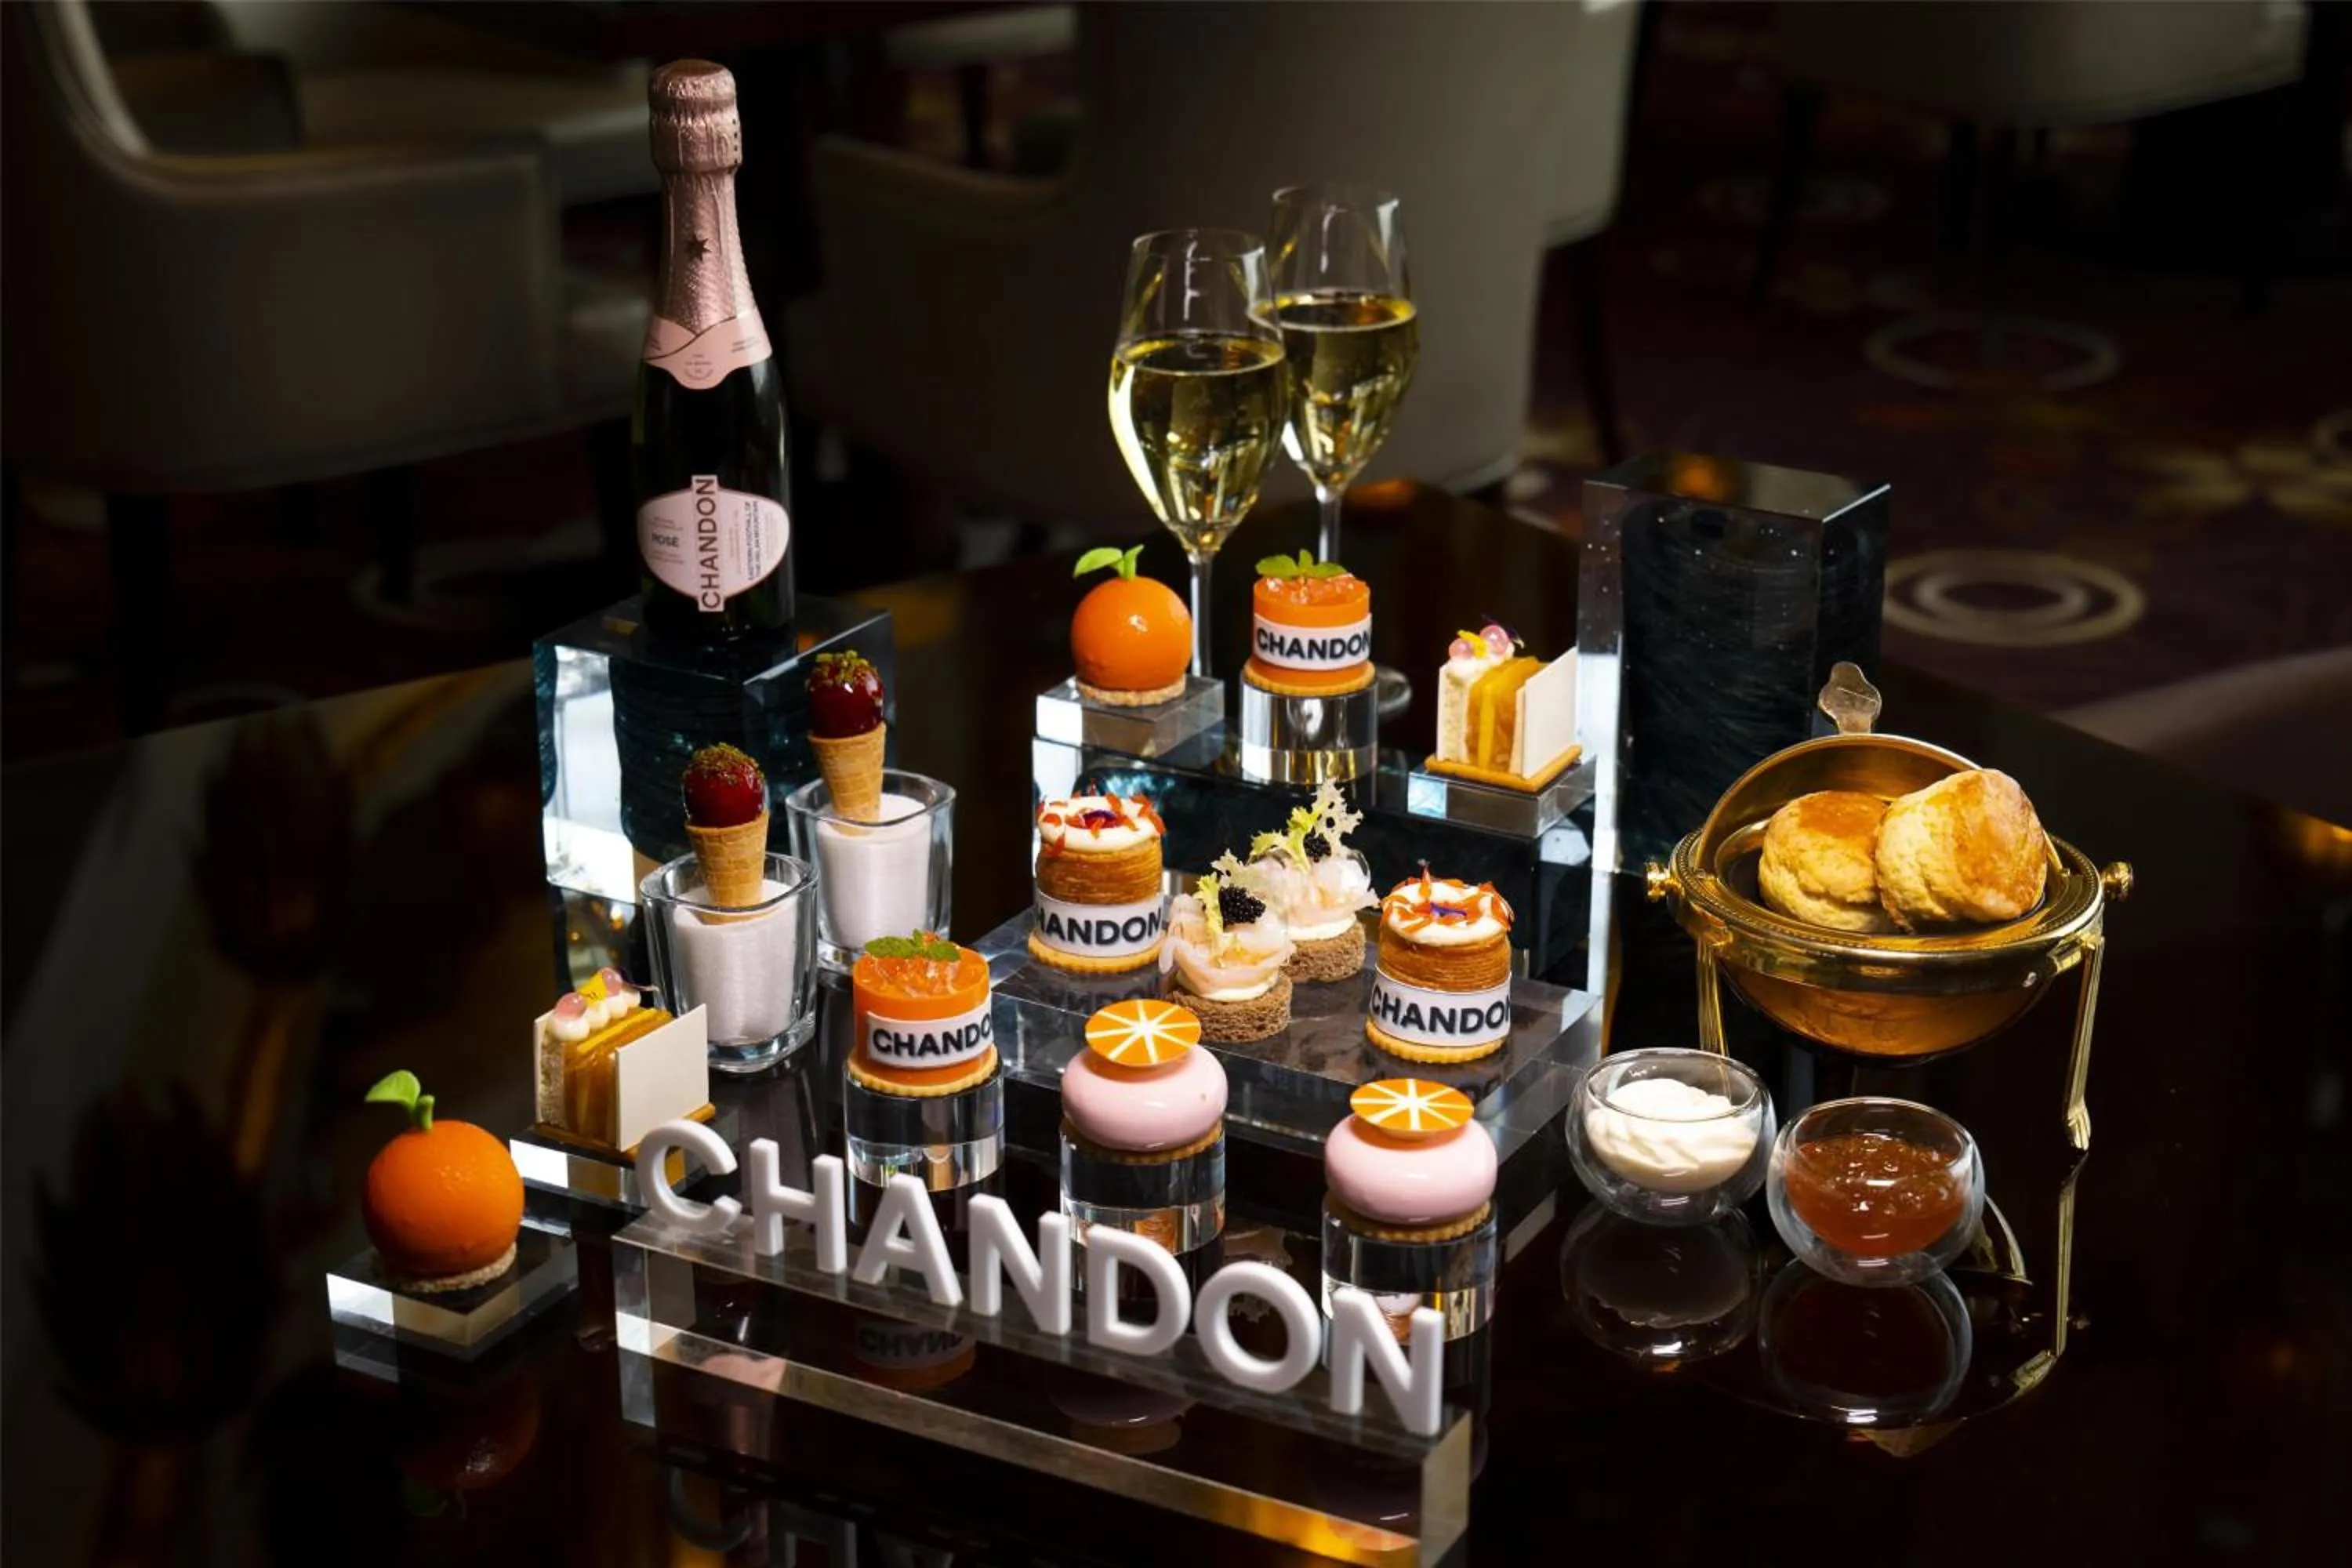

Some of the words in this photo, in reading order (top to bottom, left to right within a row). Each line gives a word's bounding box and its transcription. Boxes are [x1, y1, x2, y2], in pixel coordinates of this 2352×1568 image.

[695, 478, 721, 609] CHANDON
[1036, 907, 1162, 946] HANDON
[873, 1013, 991, 1057] CHANDO
[637, 1119, 1444, 1437] CHANDON
